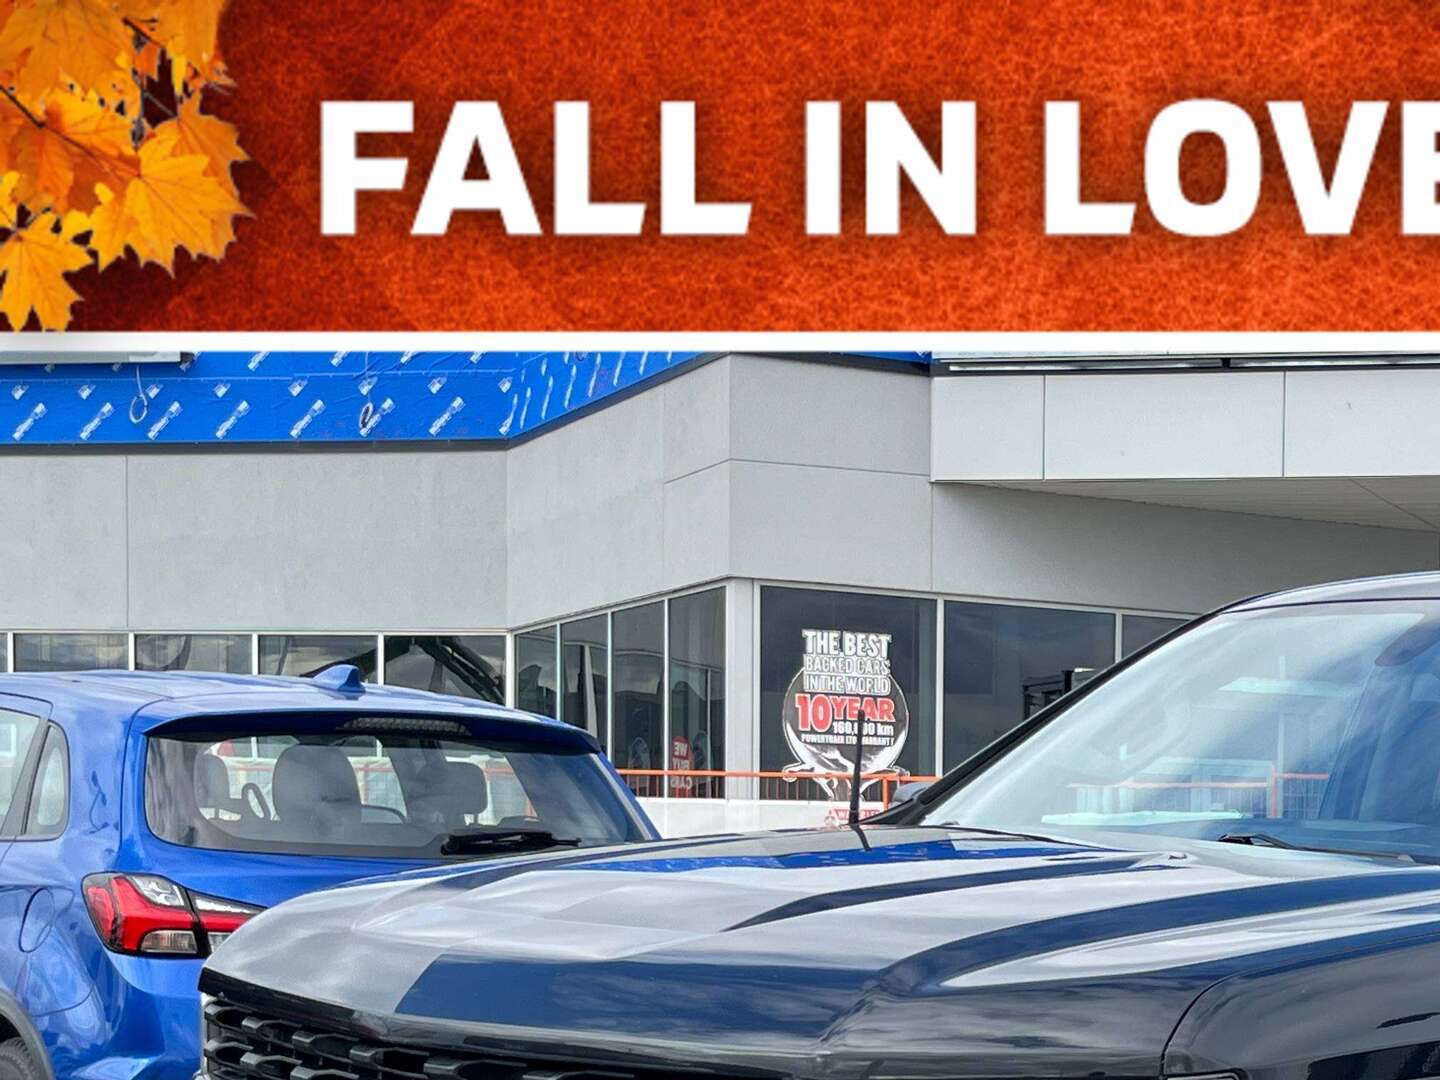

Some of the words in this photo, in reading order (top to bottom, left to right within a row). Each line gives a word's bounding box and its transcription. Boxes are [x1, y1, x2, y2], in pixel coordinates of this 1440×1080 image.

[803, 630, 839, 655] THE
[843, 632, 891, 659] BEST
[805, 655, 853, 673] BACKED
[857, 658, 891, 675] CARS
[805, 674, 817, 690] IN
[818, 675, 844, 692] THE
[846, 677, 890, 694] WORLD
[796, 693, 832, 732] 10
[831, 696, 896, 722] YEAR
[877, 722, 894, 737] km
